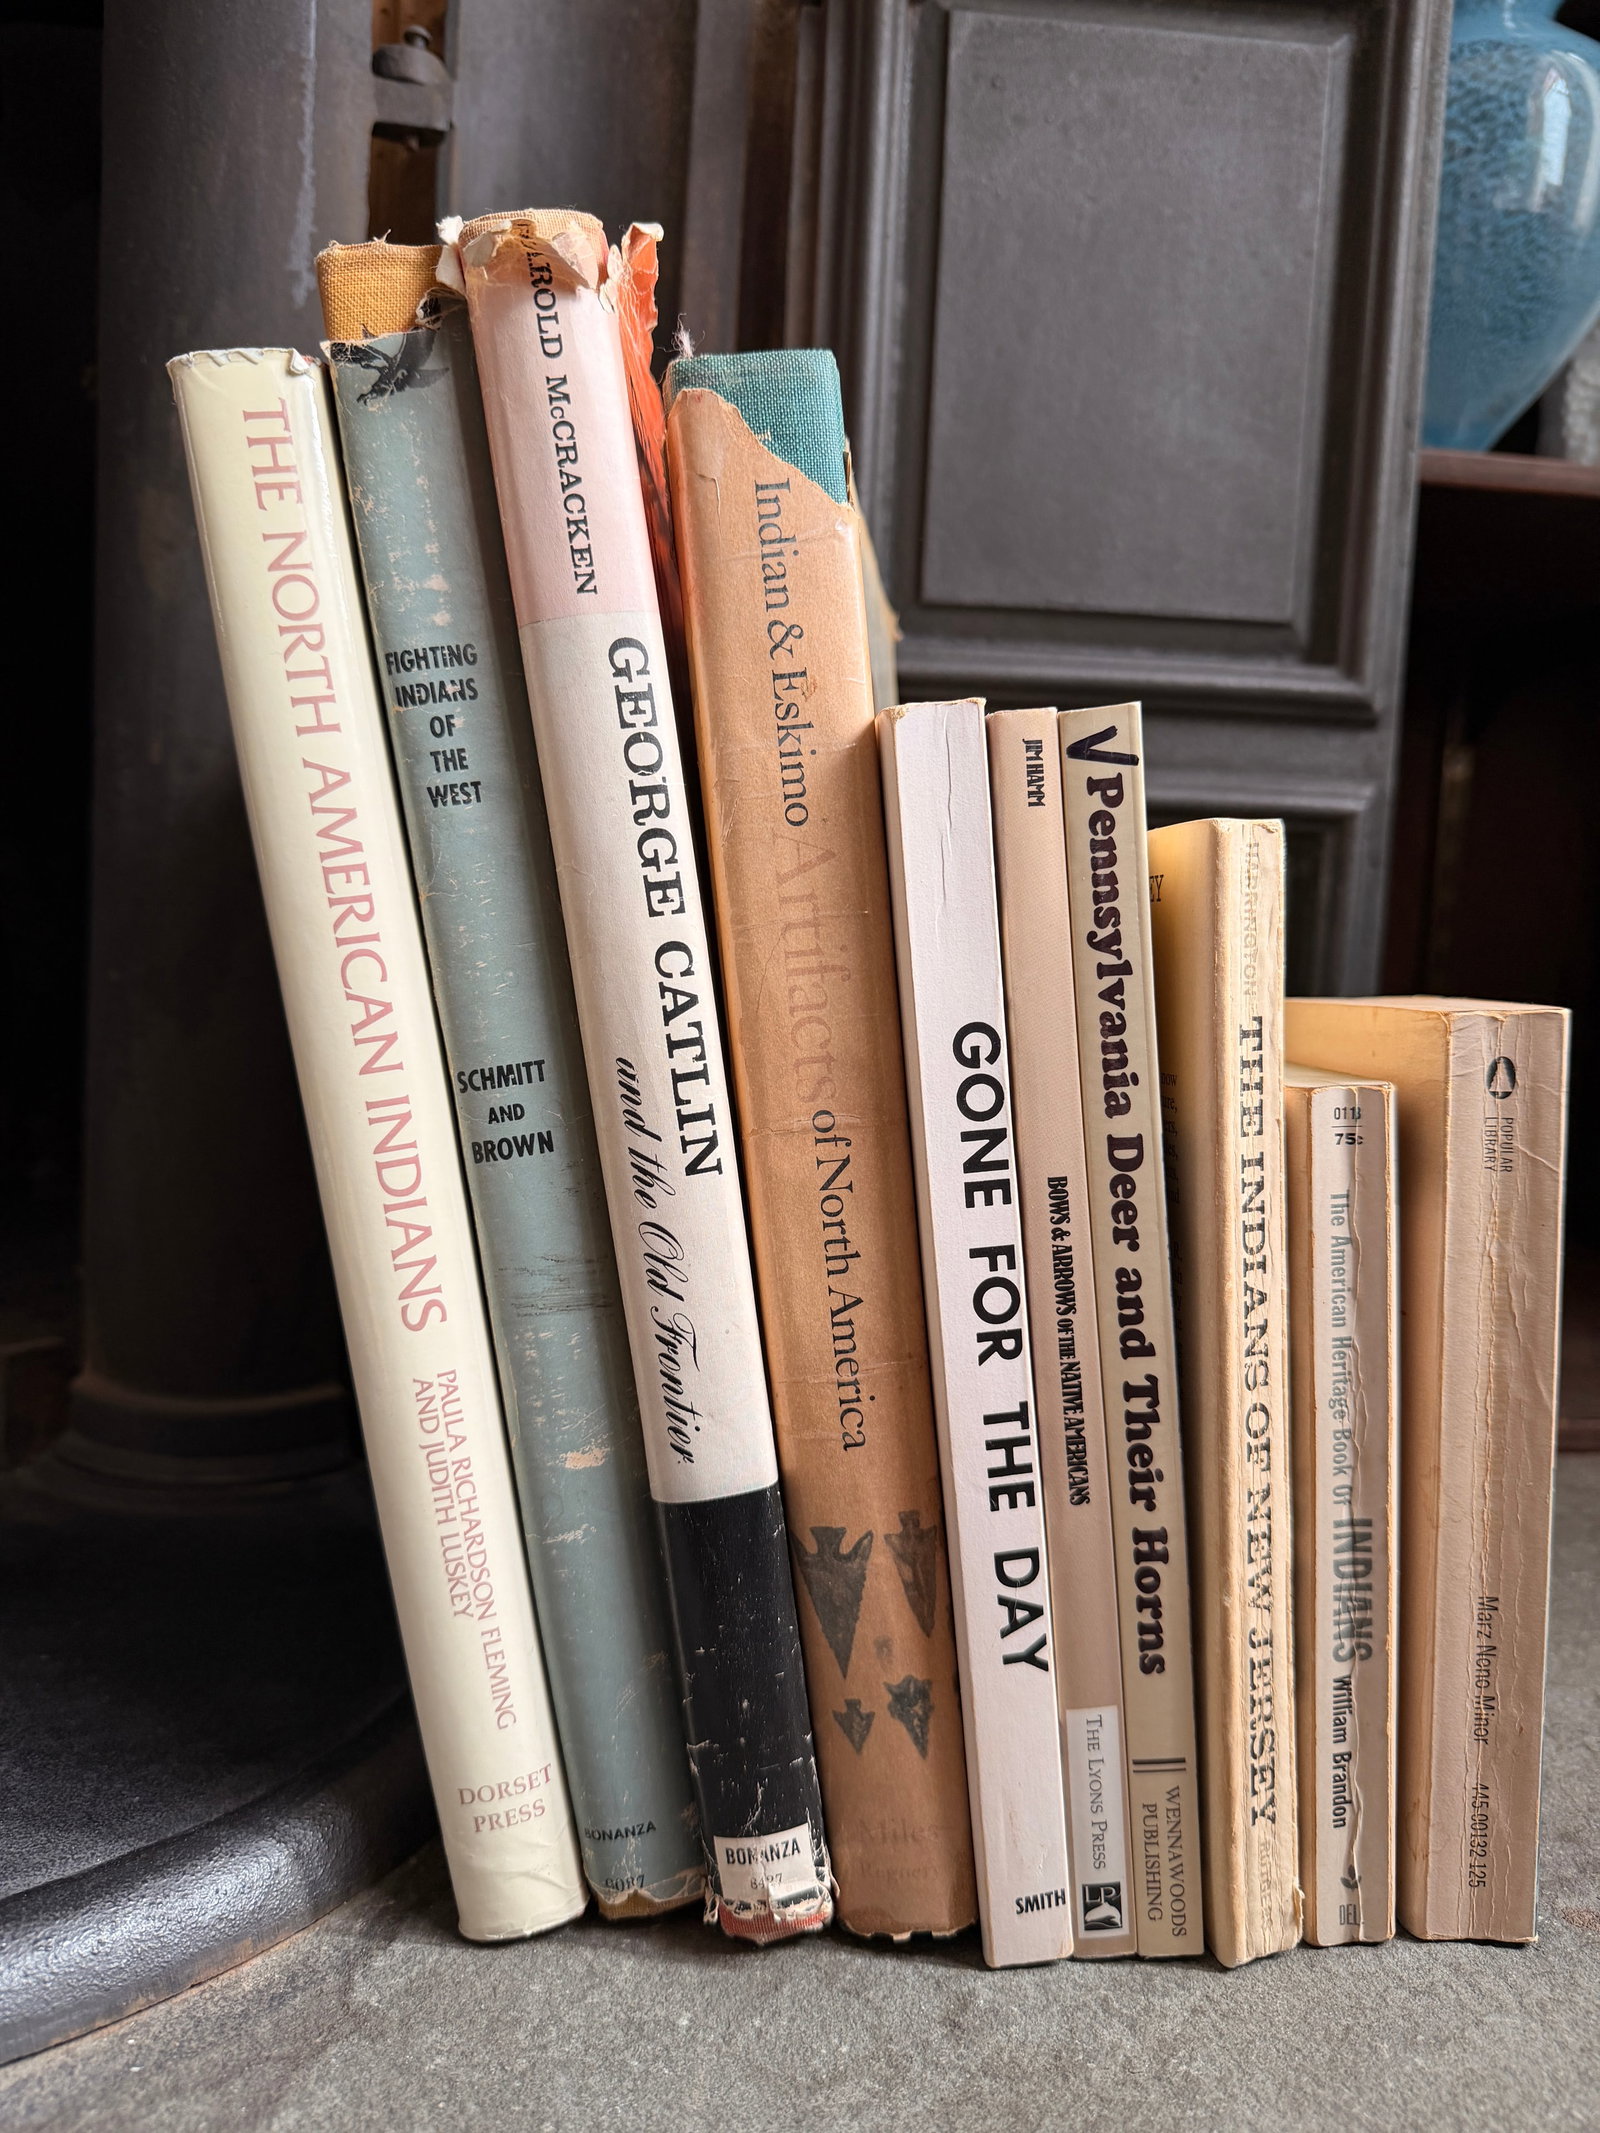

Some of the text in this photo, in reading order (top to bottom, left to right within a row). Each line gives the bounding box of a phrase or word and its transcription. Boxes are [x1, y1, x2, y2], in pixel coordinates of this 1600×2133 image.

[545, 374, 598, 595] McCRACKEN
[385, 643, 479, 676] FIGHTING
[395, 677, 479, 708] INDIANS
[429, 714, 457, 738] OF
[430, 747, 469, 773] THE
[1022, 738, 1046, 807] JIM HAMM
[426, 780, 482, 808] WEST
[242, 397, 448, 1333] THE NORTH AMERICAN INDIANS
[608, 636, 724, 1177] GEORGE CATLIN
[754, 477, 876, 1452] Indian & Eskimo Artifacts of North America
[456, 1059, 546, 1094] SCHMITT
[488, 1103, 526, 1124] AND
[1484, 1116, 1499, 1172] LIBRARY
[471, 1130, 555, 1164] BROWN
[1500, 1117, 1514, 1173] POPULAR
[1086, 772, 1169, 1676] Pennsylvania Deer and Their Horns
[1330, 1189, 1350, 1227] The
[615, 1056, 704, 1465] and the Old Frontier
[1330, 1235, 1352, 1328] American
[952, 1021, 1050, 1673] GONE FOR THE DAY
[1047, 1176, 1091, 1506] BOWS & ARROWS OF THE NATIVE AMERICANS
[1328, 1335, 1353, 1421] Heritage
[1239, 1015, 1276, 1827] THE INDIANS OF NEW JERSEY
[1332, 1427, 1352, 1477] Book
[412, 1377, 475, 1620] AND JUDITH LUSKEY
[436, 1368, 517, 1730] PAULA RICHARDSON FLEMING
[1332, 1517, 1373, 1663] INDIANS
[1478, 1595, 1500, 1640] Marz
[1473, 1693, 1496, 1745] Minor
[1332, 1674, 1353, 1829] William Brandon
[457, 1763, 552, 1806] DORSET
[472, 1798, 546, 1833] PRESS
[1086, 1714, 1108, 1870] THE LYONS PRESS
[584, 1819, 657, 1842] BONANZA
[725, 1837, 802, 1866] BONANZA
[1165, 1785, 1188, 1938] WENNAWOODS
[1142, 1803, 1164, 1922] PUBLISHING
[1015, 1887, 1066, 1915] SMITH
